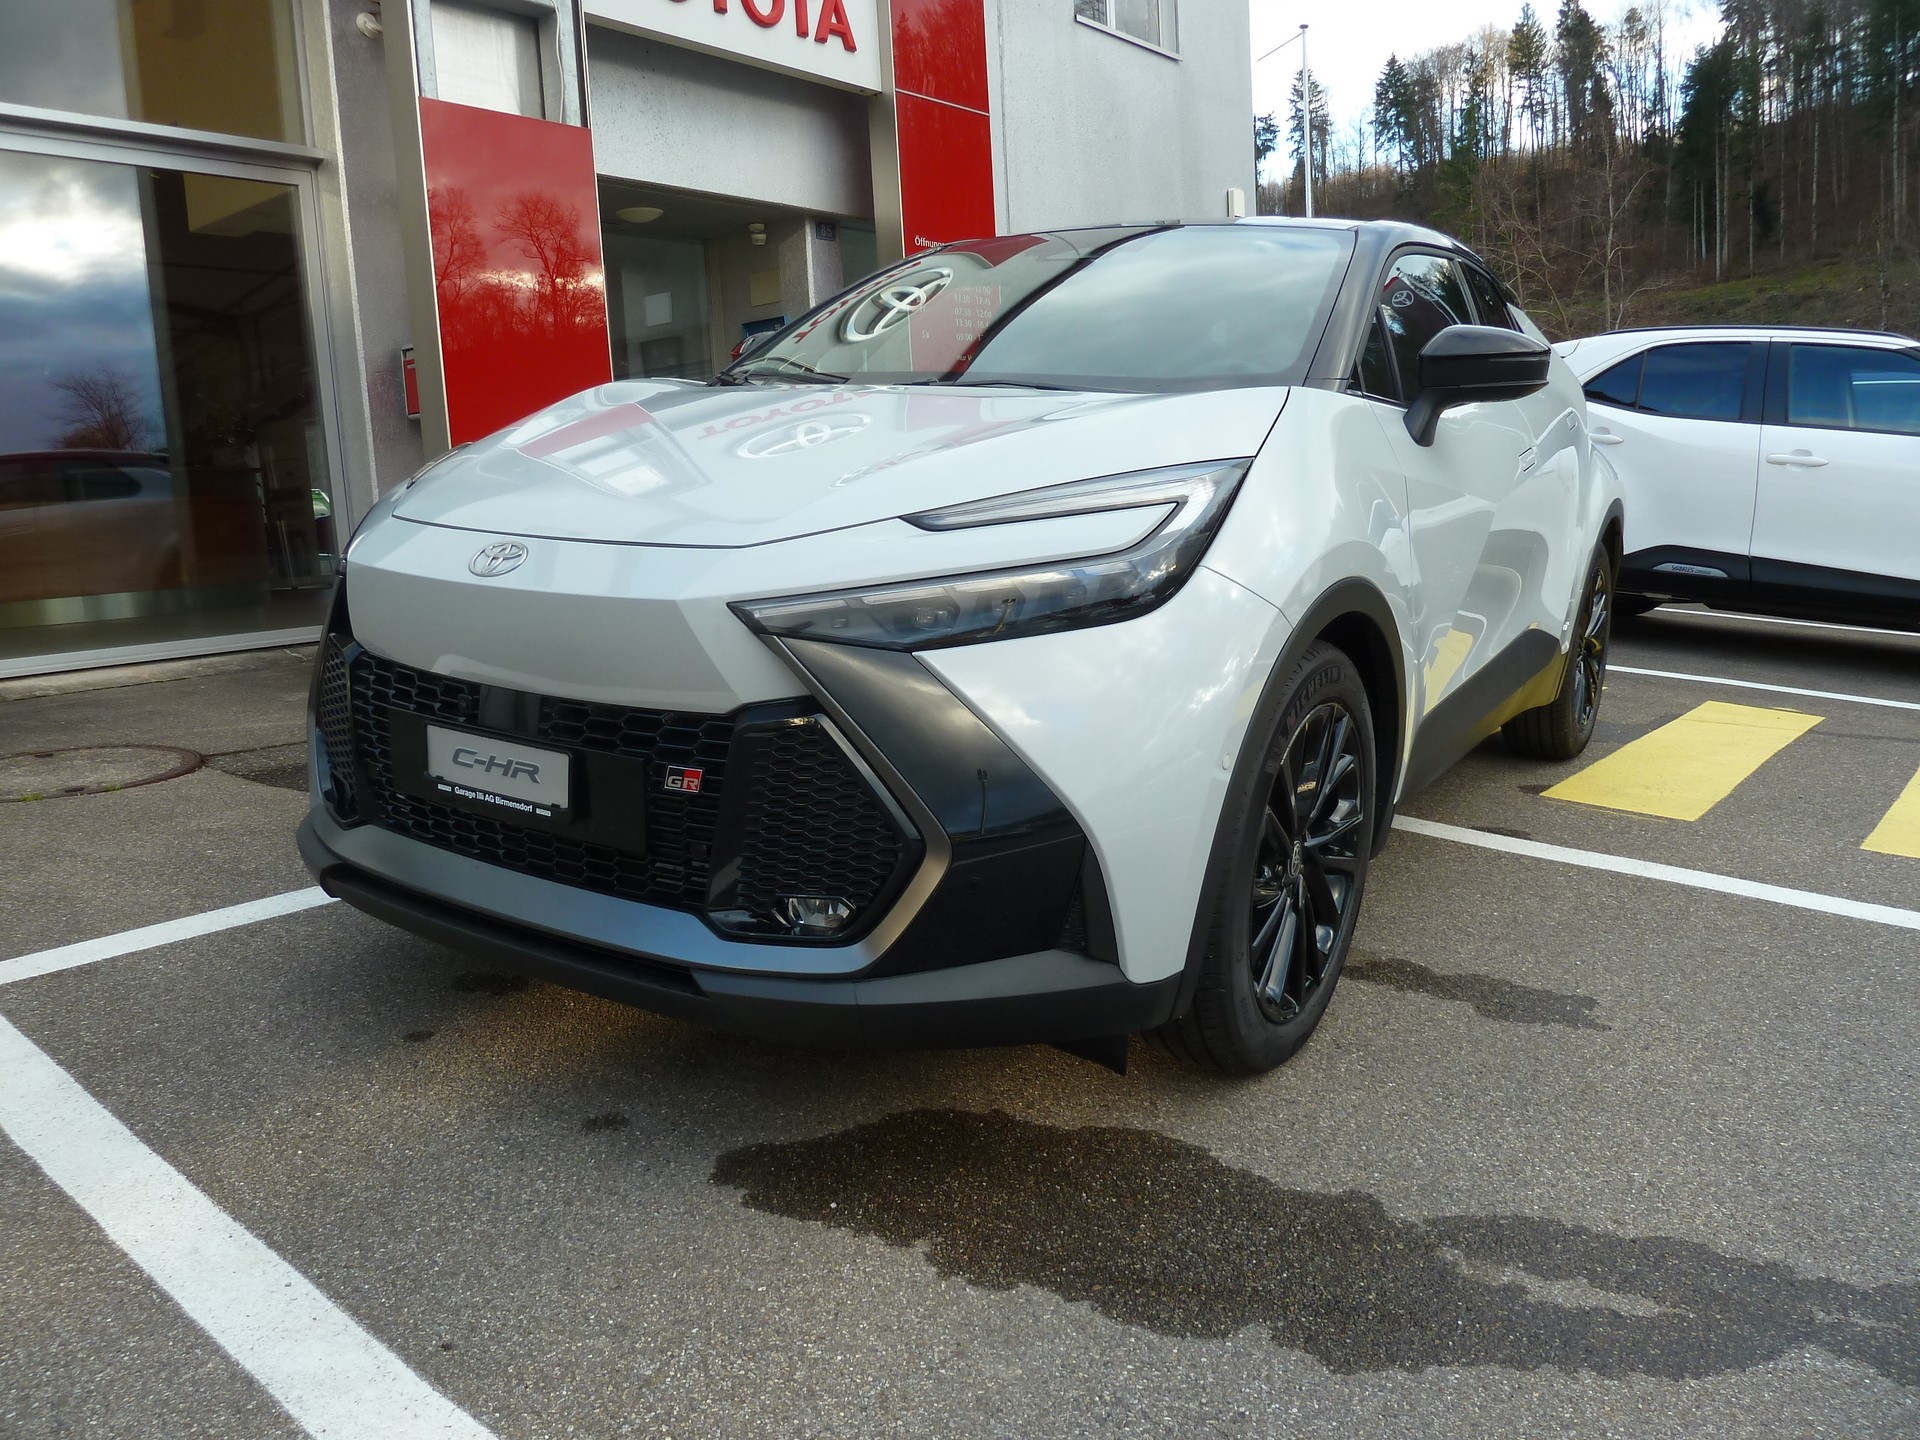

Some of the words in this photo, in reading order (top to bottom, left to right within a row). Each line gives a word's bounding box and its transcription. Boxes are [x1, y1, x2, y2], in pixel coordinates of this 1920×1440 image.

[1671, 564, 1696, 573] YARIS
[452, 747, 541, 784] C-HR
[666, 775, 700, 790] GR
[454, 786, 476, 799] Garage
[484, 794, 495, 803] AG
[495, 796, 533, 812] Birmensdorf
